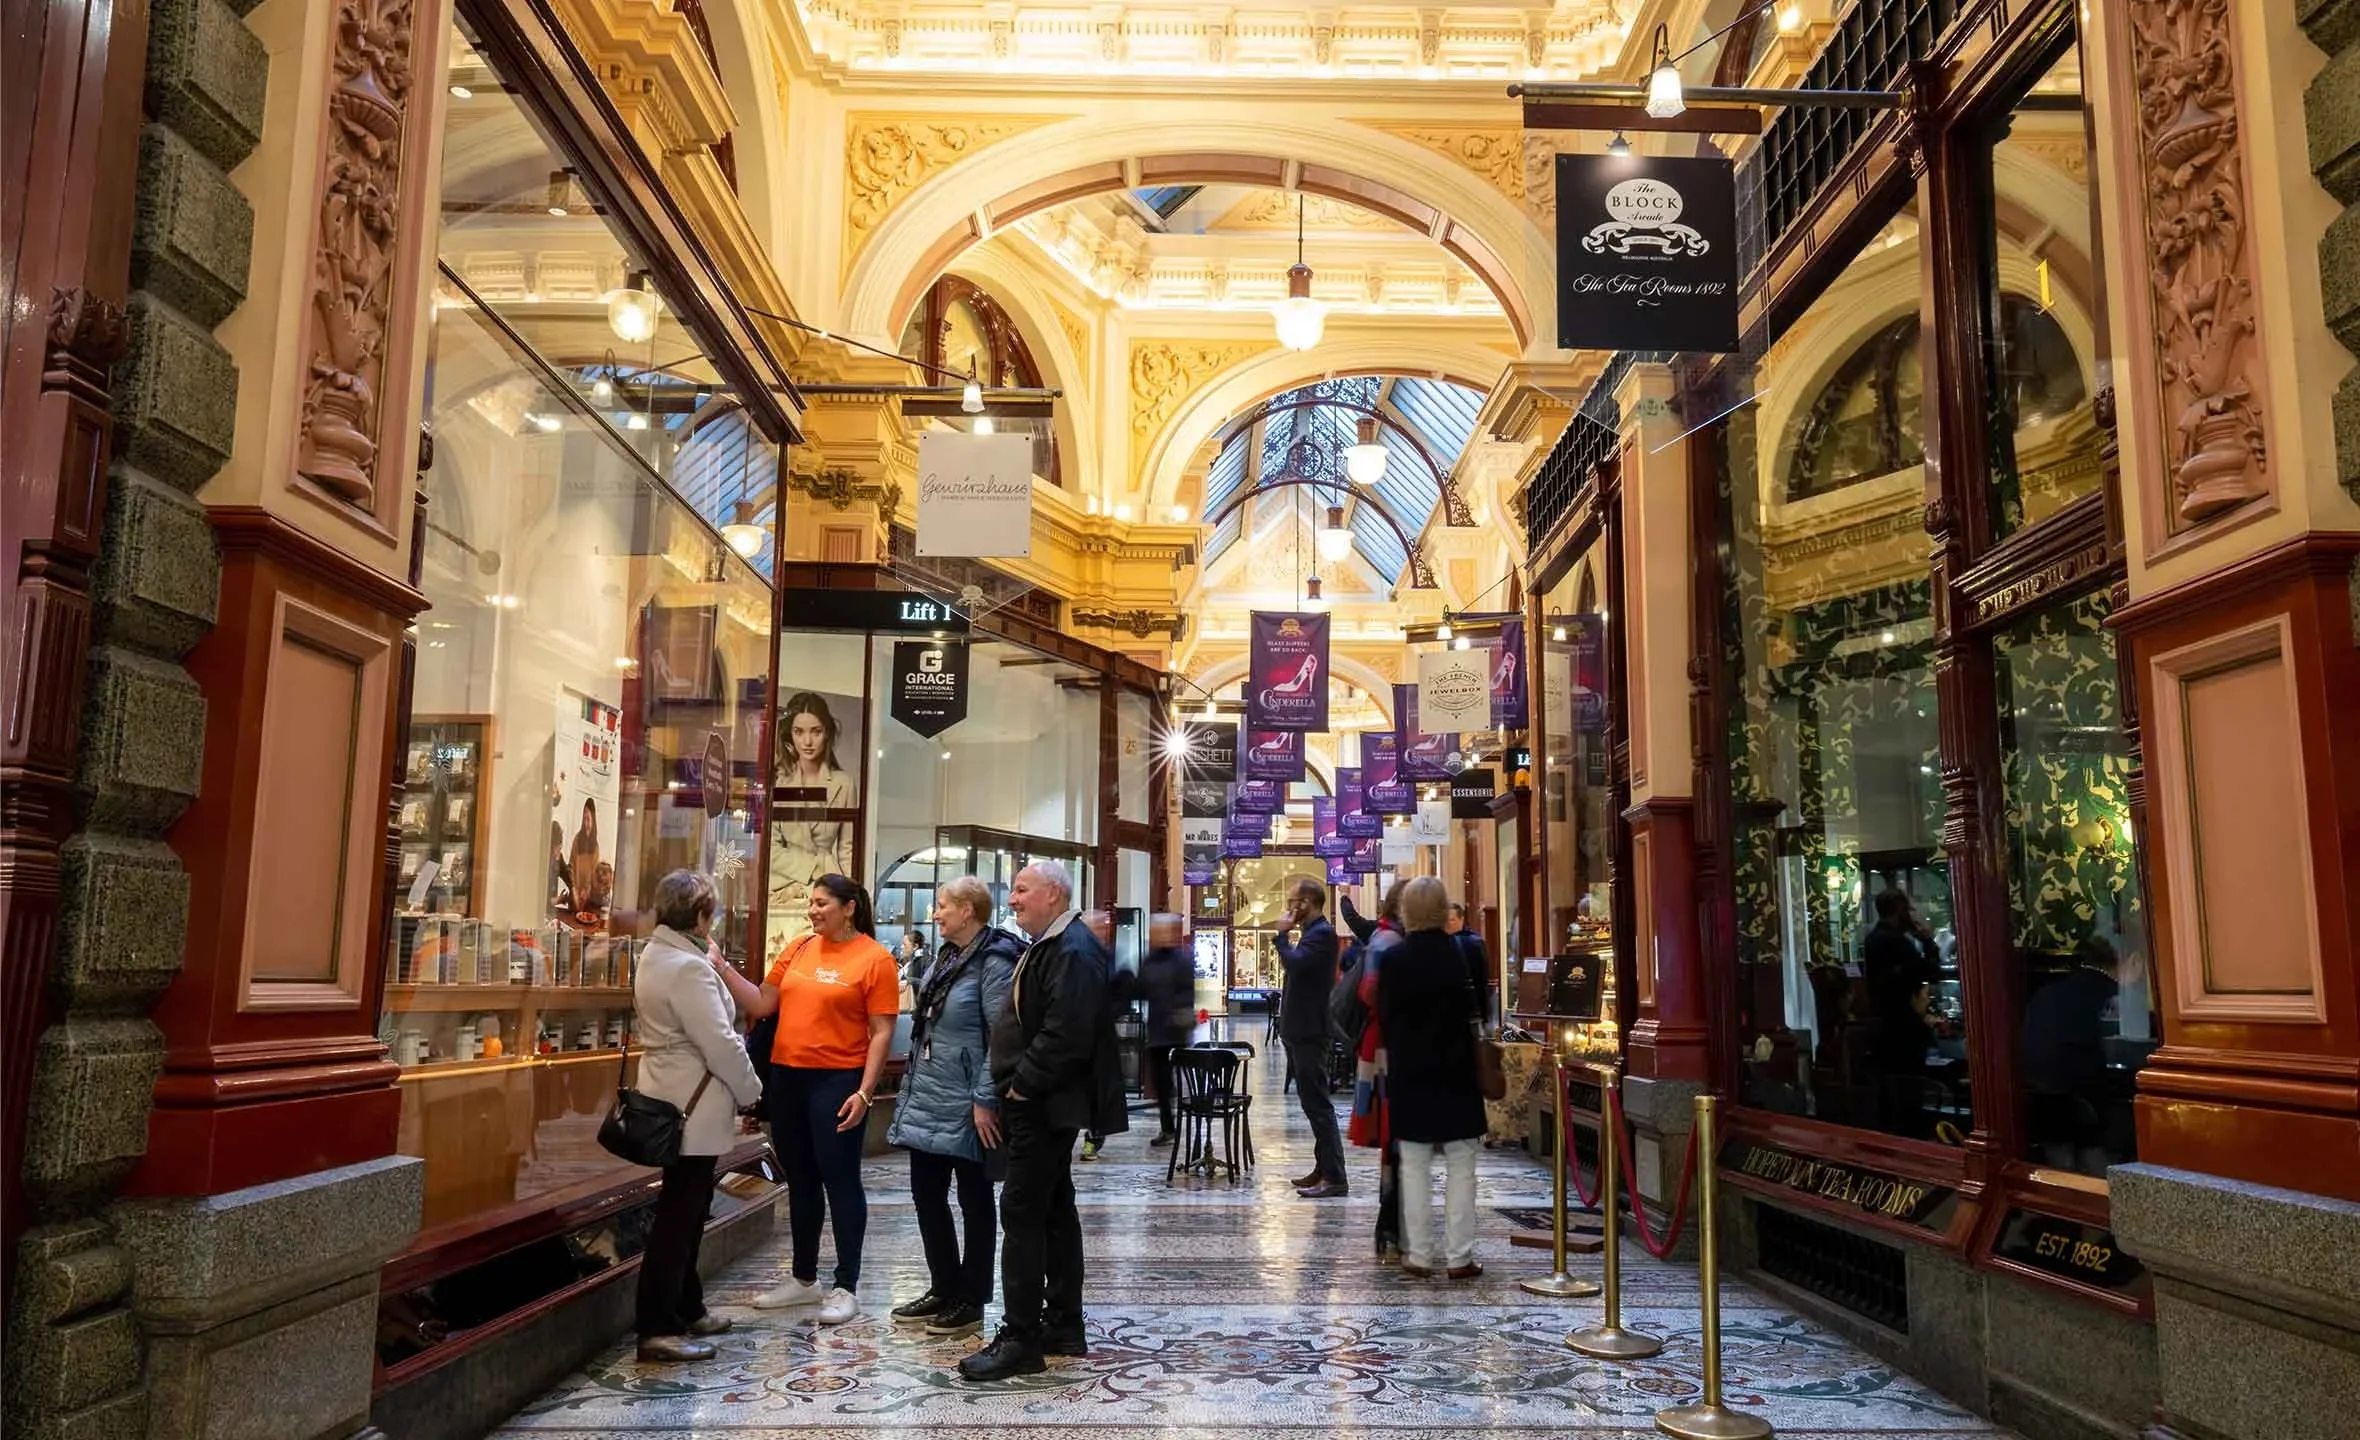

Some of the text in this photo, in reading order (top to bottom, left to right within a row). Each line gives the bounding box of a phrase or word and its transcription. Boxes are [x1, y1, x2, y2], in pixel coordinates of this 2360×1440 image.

[1633, 183, 1656, 193] The
[1612, 196, 1678, 209] BLOCK
[1627, 212, 1664, 221] Arcade
[1573, 273, 1727, 296] The Tea Rooms 1892
[901, 602, 951, 620] Lift 1
[906, 673, 955, 685] GRACE
[1449, 673, 1477, 685] FRENCH
[1430, 687, 1480, 695] JEWELBOX
[1260, 689, 1316, 712] CINDERELLA
[1743, 1146, 1923, 1218] HOPETOUN TEA ROOMS
[2035, 1232, 2111, 1272] EST. 1892
